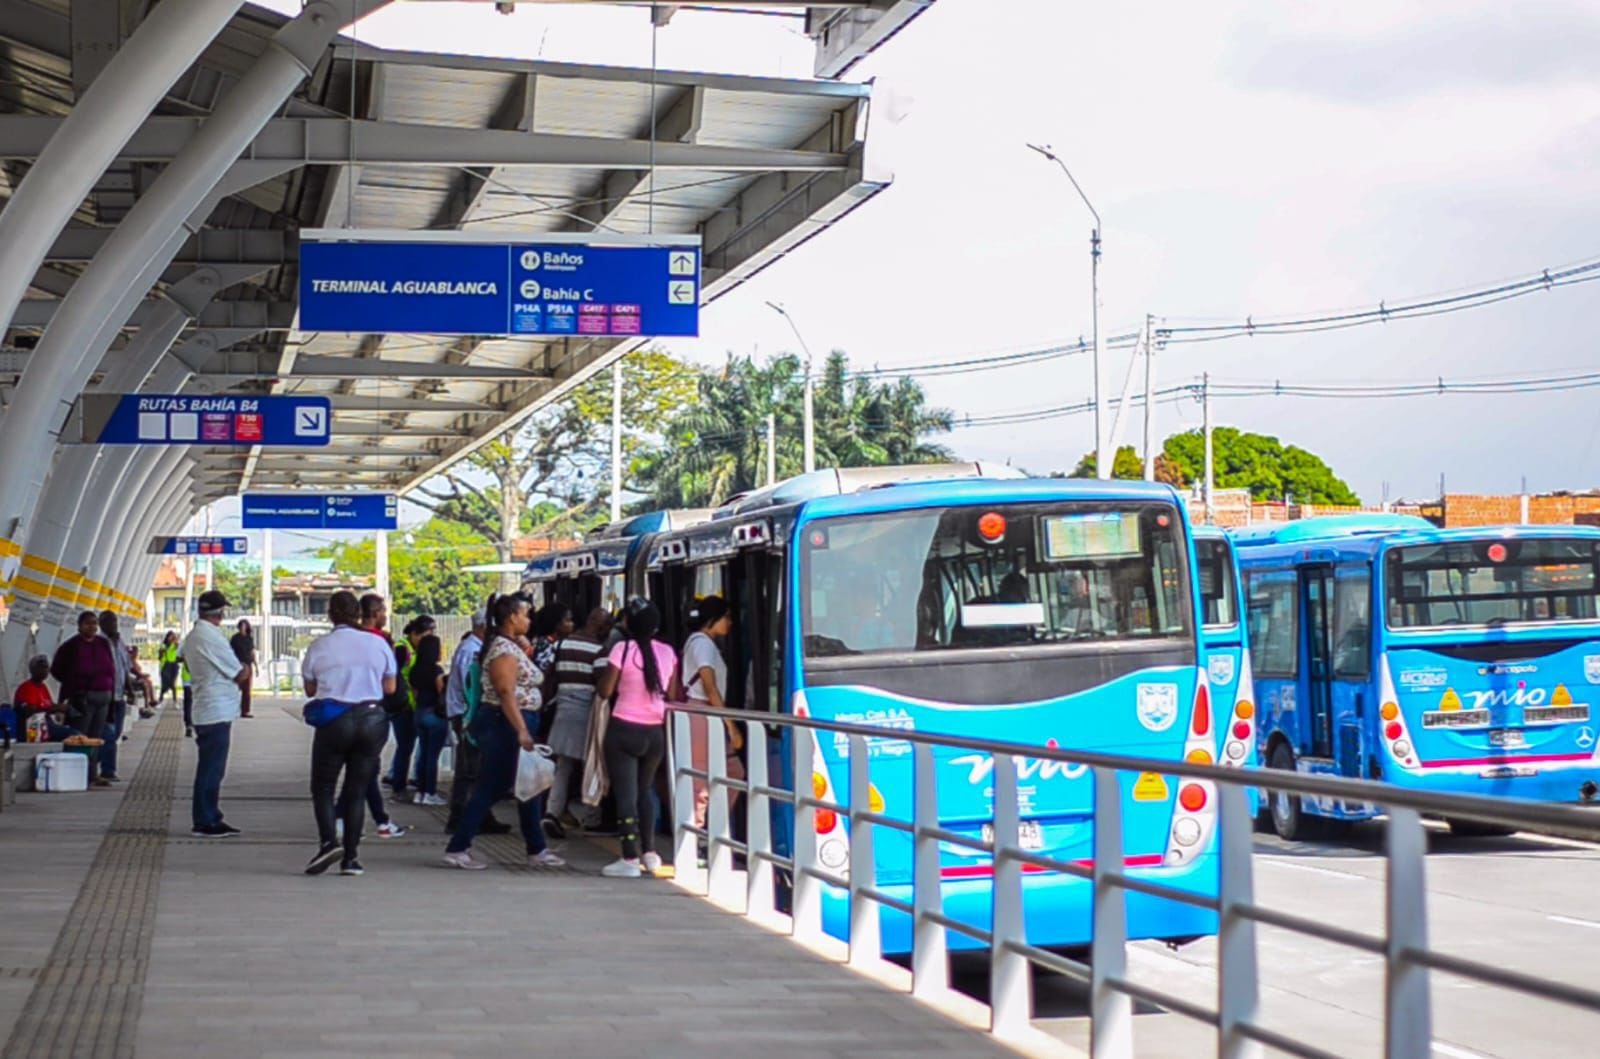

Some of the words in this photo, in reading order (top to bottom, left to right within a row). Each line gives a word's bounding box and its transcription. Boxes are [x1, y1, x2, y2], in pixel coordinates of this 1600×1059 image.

[543, 251, 583, 265] Baños
[312, 279, 388, 294] TERMINAL
[391, 280, 498, 295] AGUABLANCA
[543, 287, 580, 300] Bahía
[583, 288, 594, 301] C
[138, 398, 188, 411] RUTAS
[190, 396, 236, 411] BAHÍA
[240, 399, 259, 412] B4
[1463, 680, 1546, 708] mio
